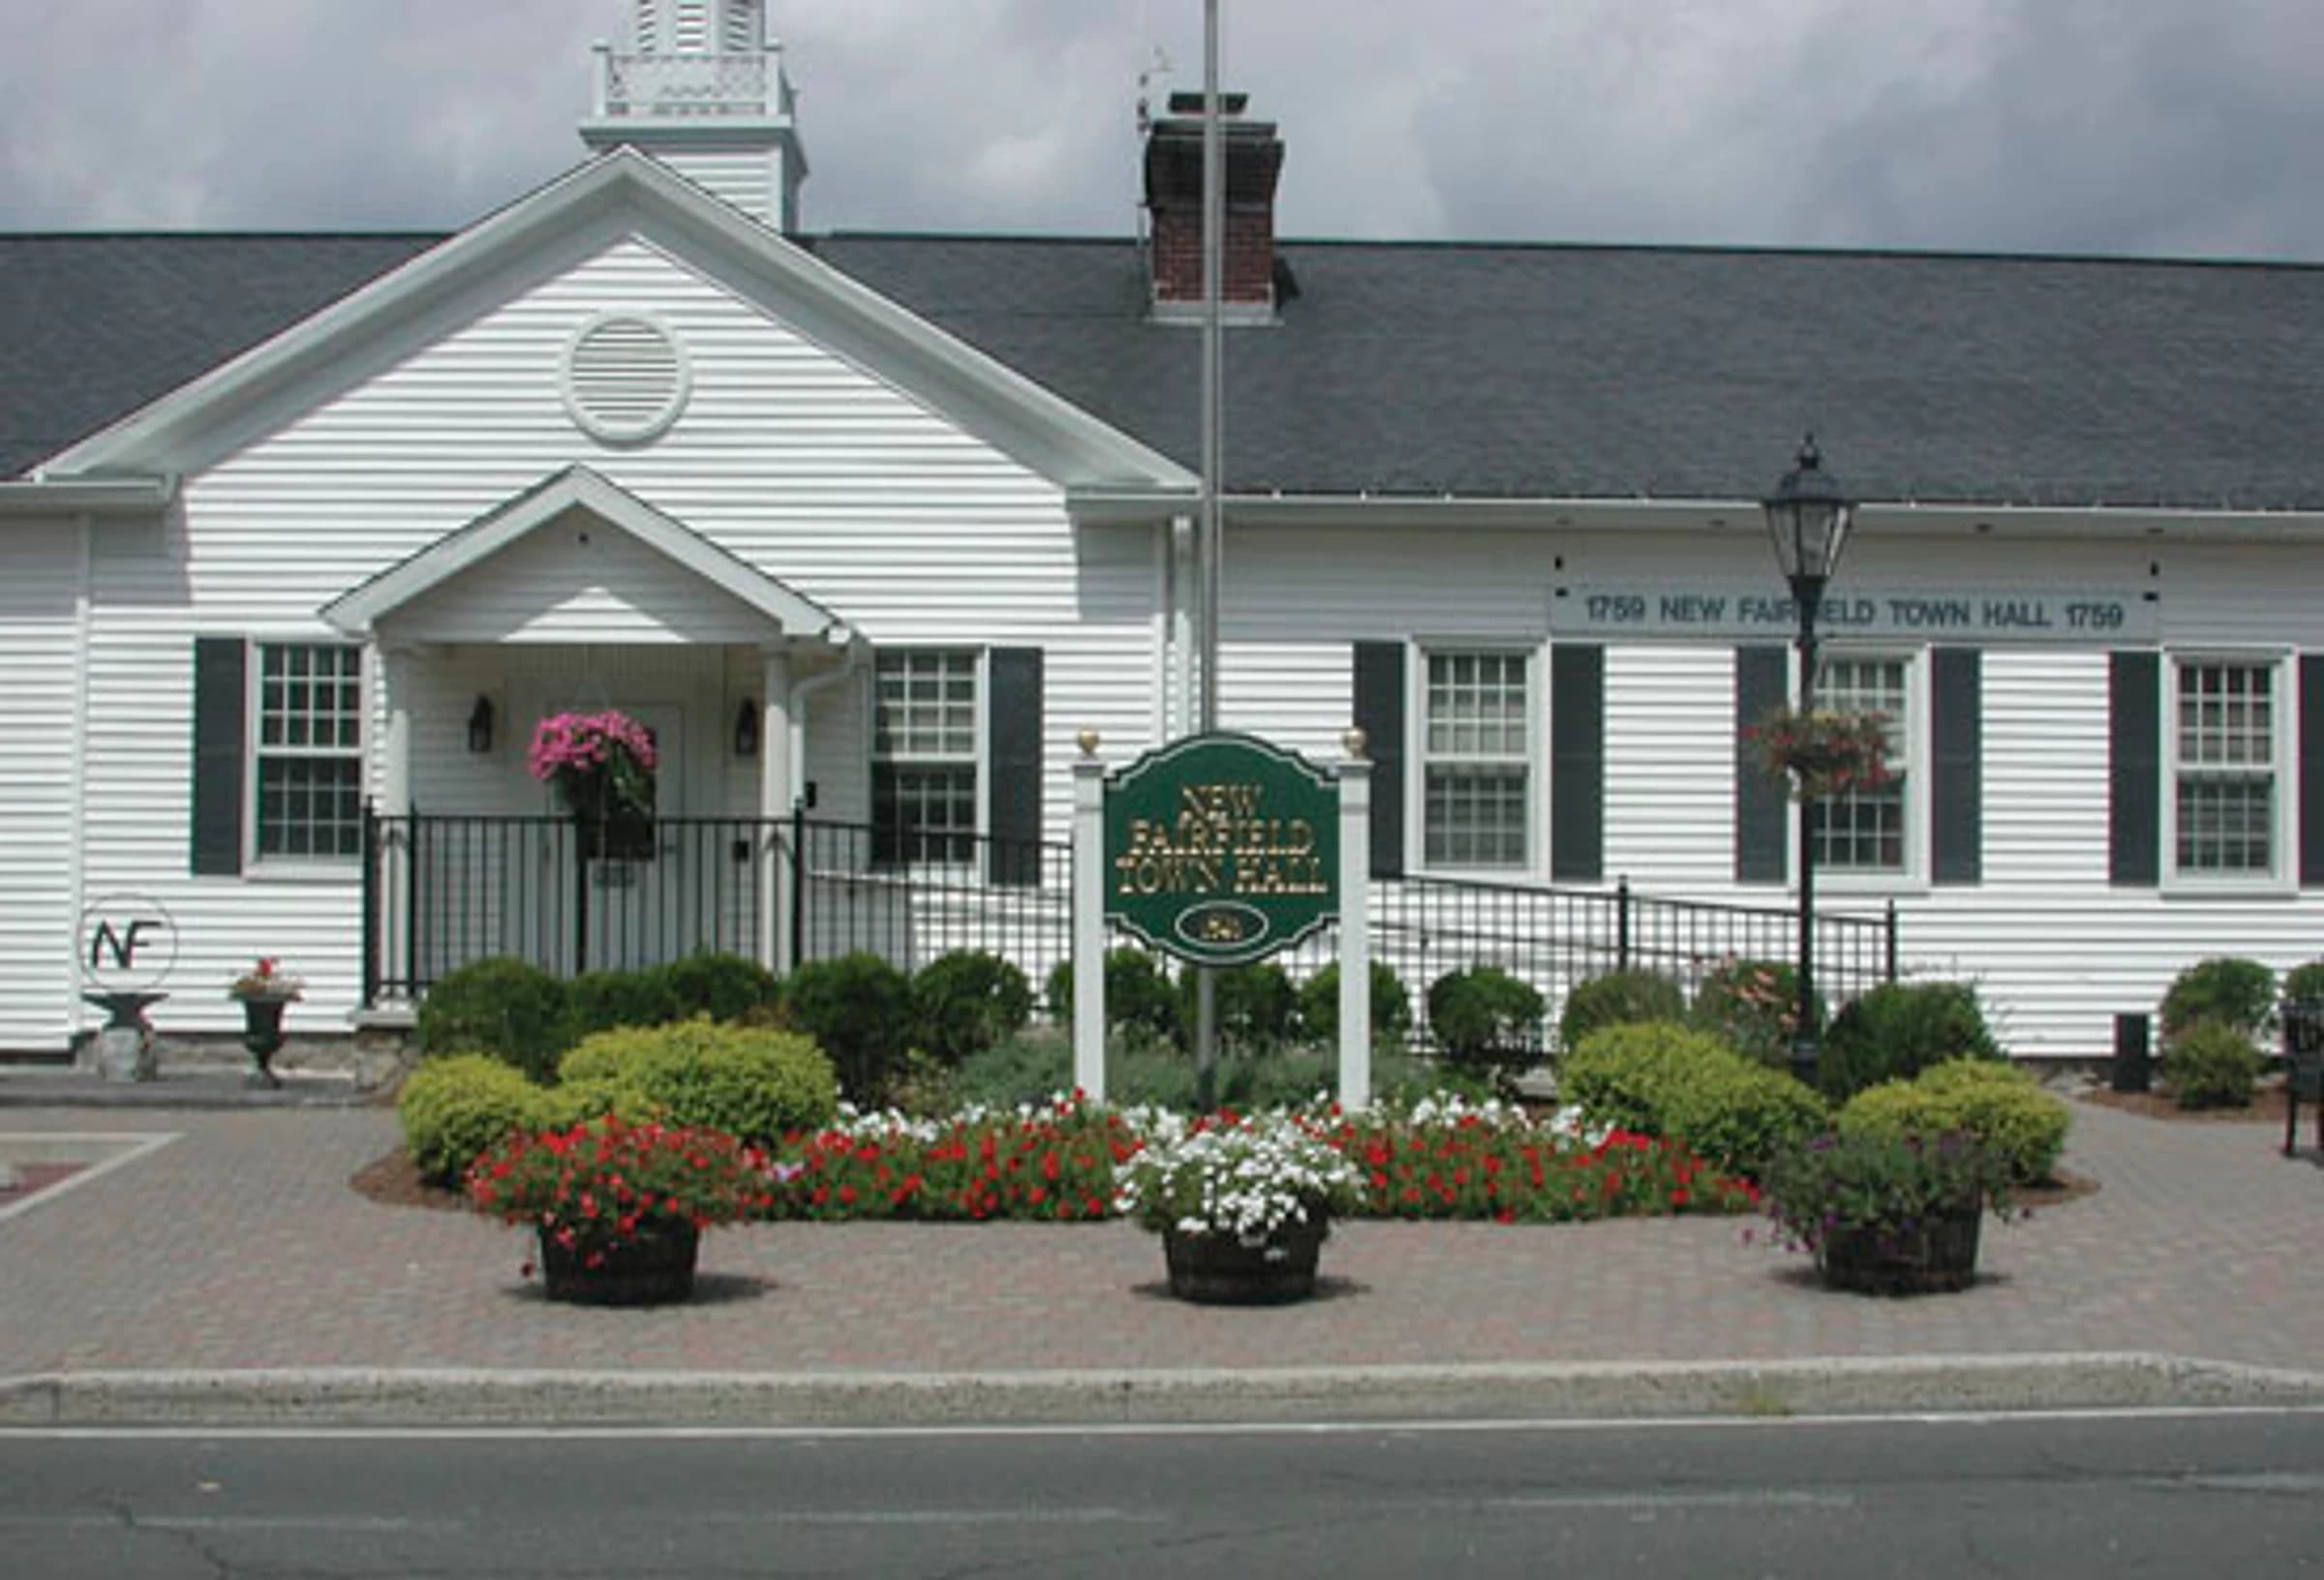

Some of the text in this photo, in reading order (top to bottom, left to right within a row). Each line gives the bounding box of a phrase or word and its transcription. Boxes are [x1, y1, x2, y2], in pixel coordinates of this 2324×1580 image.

[1587, 594, 1644, 622] 1759
[1661, 595, 1725, 623] NEW
[1889, 598, 1970, 627] TOWN
[1982, 601, 2051, 628] HALL
[2065, 602, 2124, 629] 1759
[1183, 785, 1263, 820] NEW
[1130, 819, 1314, 856] FAIRFIELD
[1116, 857, 1328, 893] TOWN HALL
[92, 921, 162, 969] NF
